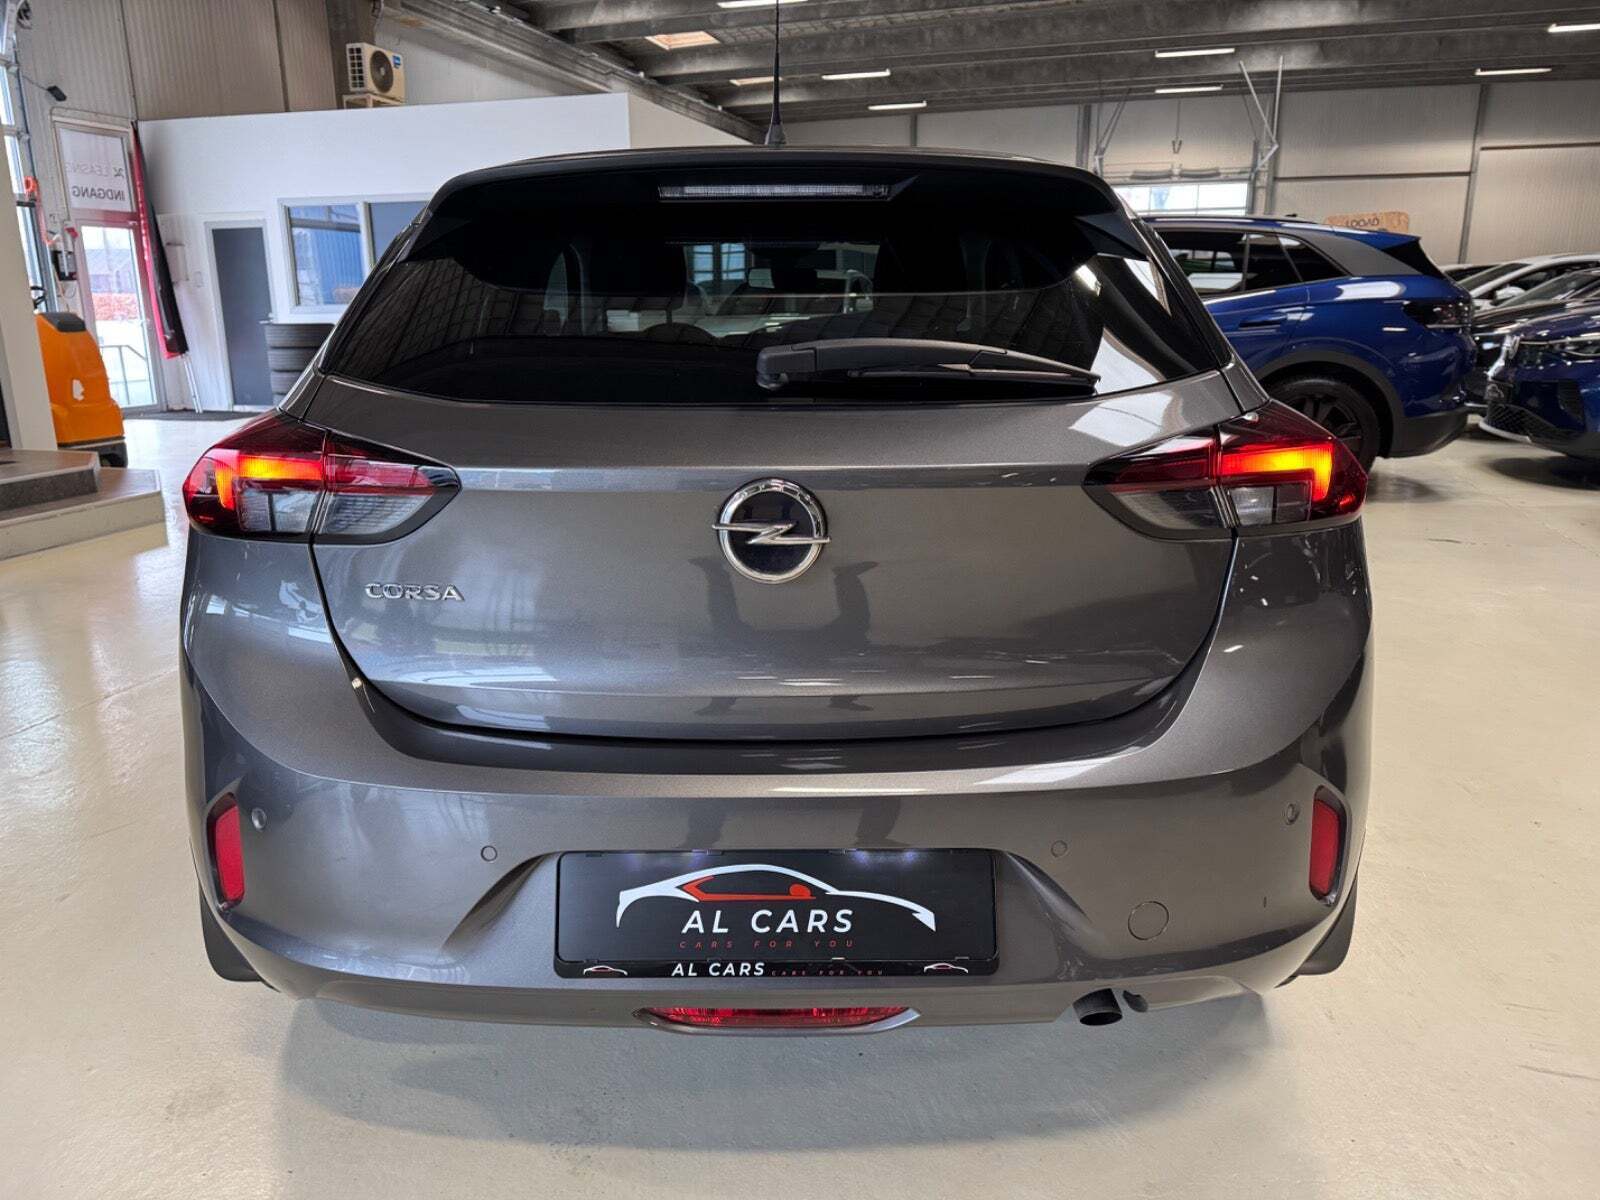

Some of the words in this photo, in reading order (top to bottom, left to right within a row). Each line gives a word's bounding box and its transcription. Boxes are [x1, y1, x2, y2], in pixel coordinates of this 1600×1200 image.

[364, 582, 465, 602] CORSA
[681, 909, 729, 934] AL
[750, 908, 854, 934] CARS
[679, 940, 733, 949] CARS
[753, 940, 793, 949] FOR
[813, 939, 854, 948] YOU
[671, 961, 698, 977] AL
[708, 961, 766, 977] CARS
